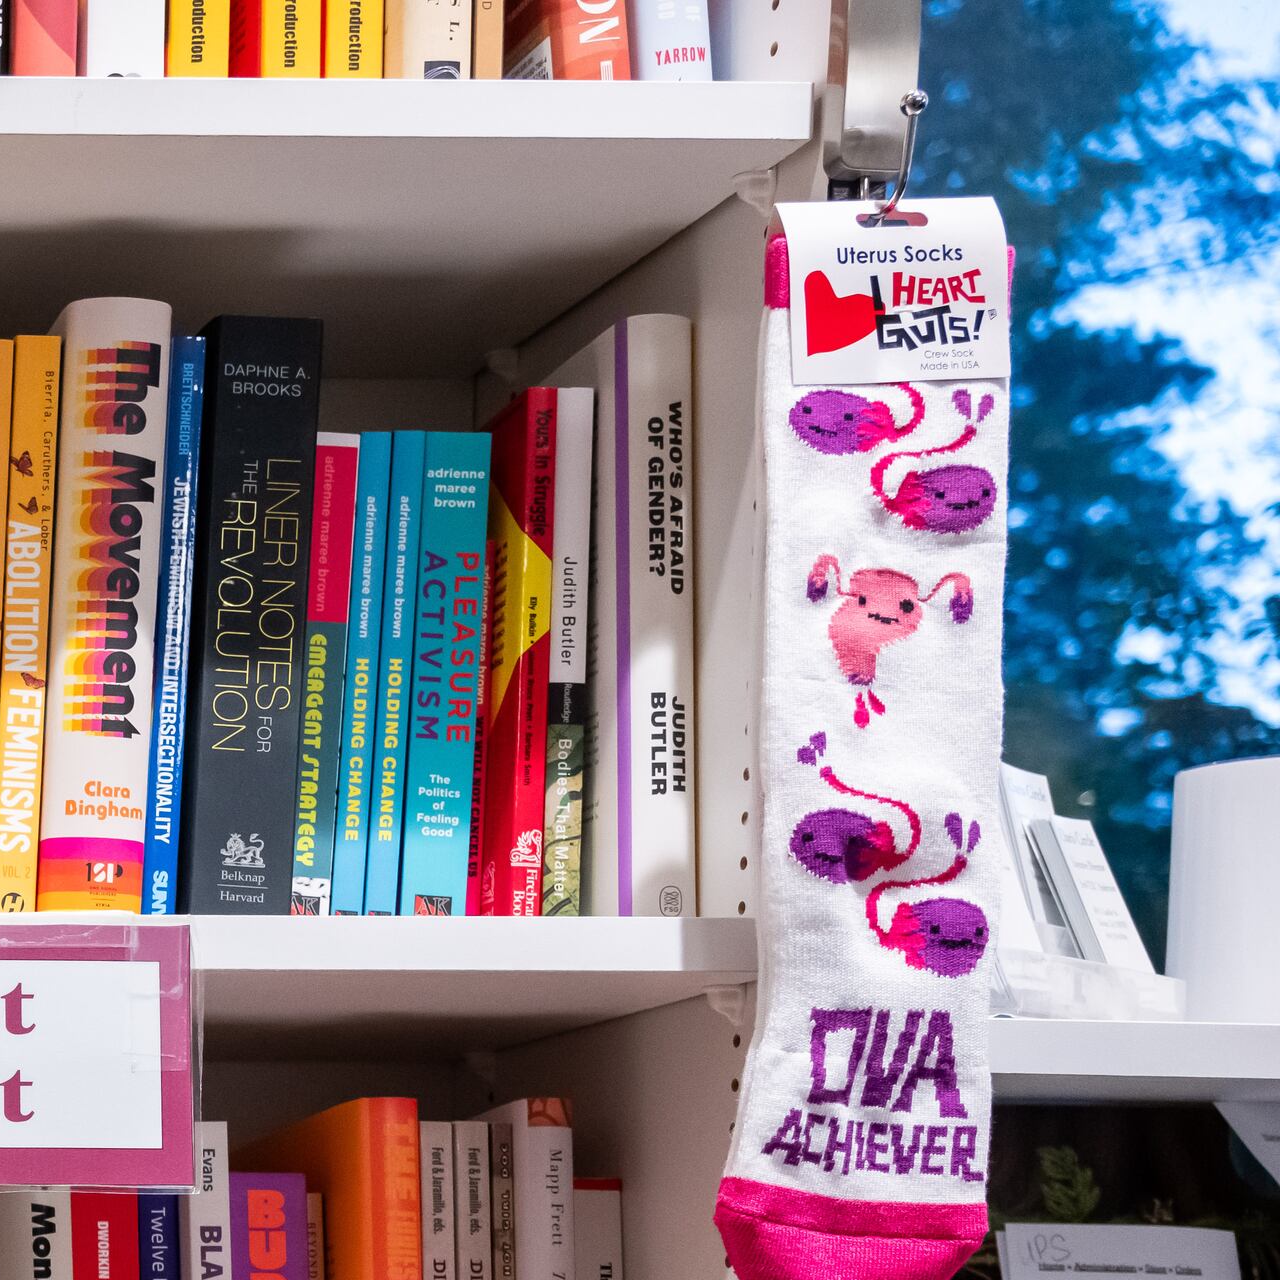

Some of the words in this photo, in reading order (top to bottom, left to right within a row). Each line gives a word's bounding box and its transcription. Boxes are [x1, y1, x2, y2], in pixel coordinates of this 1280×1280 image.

[655, 47, 706, 66] YARROW
[836, 246, 897, 265] Uterus
[904, 244, 963, 263] Socks
[869, 274, 885, 311] I
[892, 268, 986, 307] HEART
[875, 305, 985, 351] GUTS!
[924, 349, 947, 359] Crew
[949, 349, 974, 359] Sock
[920, 361, 946, 371] Made
[950, 360, 958, 369] in
[961, 360, 980, 370] USA
[648, 415, 666, 450] OF
[668, 401, 684, 490] WHO'S
[648, 455, 667, 578] GENDER?
[669, 496, 685, 595] AFRAID
[383, 657, 403, 750] HOLDING
[650, 690, 667, 796] BUTLER
[671, 695, 686, 793] JUDITH
[64, 799, 143, 821] Bingham
[83, 780, 132, 799] Clara
[378, 756, 399, 842] CHANGE
[806, 1006, 968, 1119] OVA
[761, 1108, 984, 1182] ACHIEVER
[97, 1220, 110, 1279] DWORKIN
